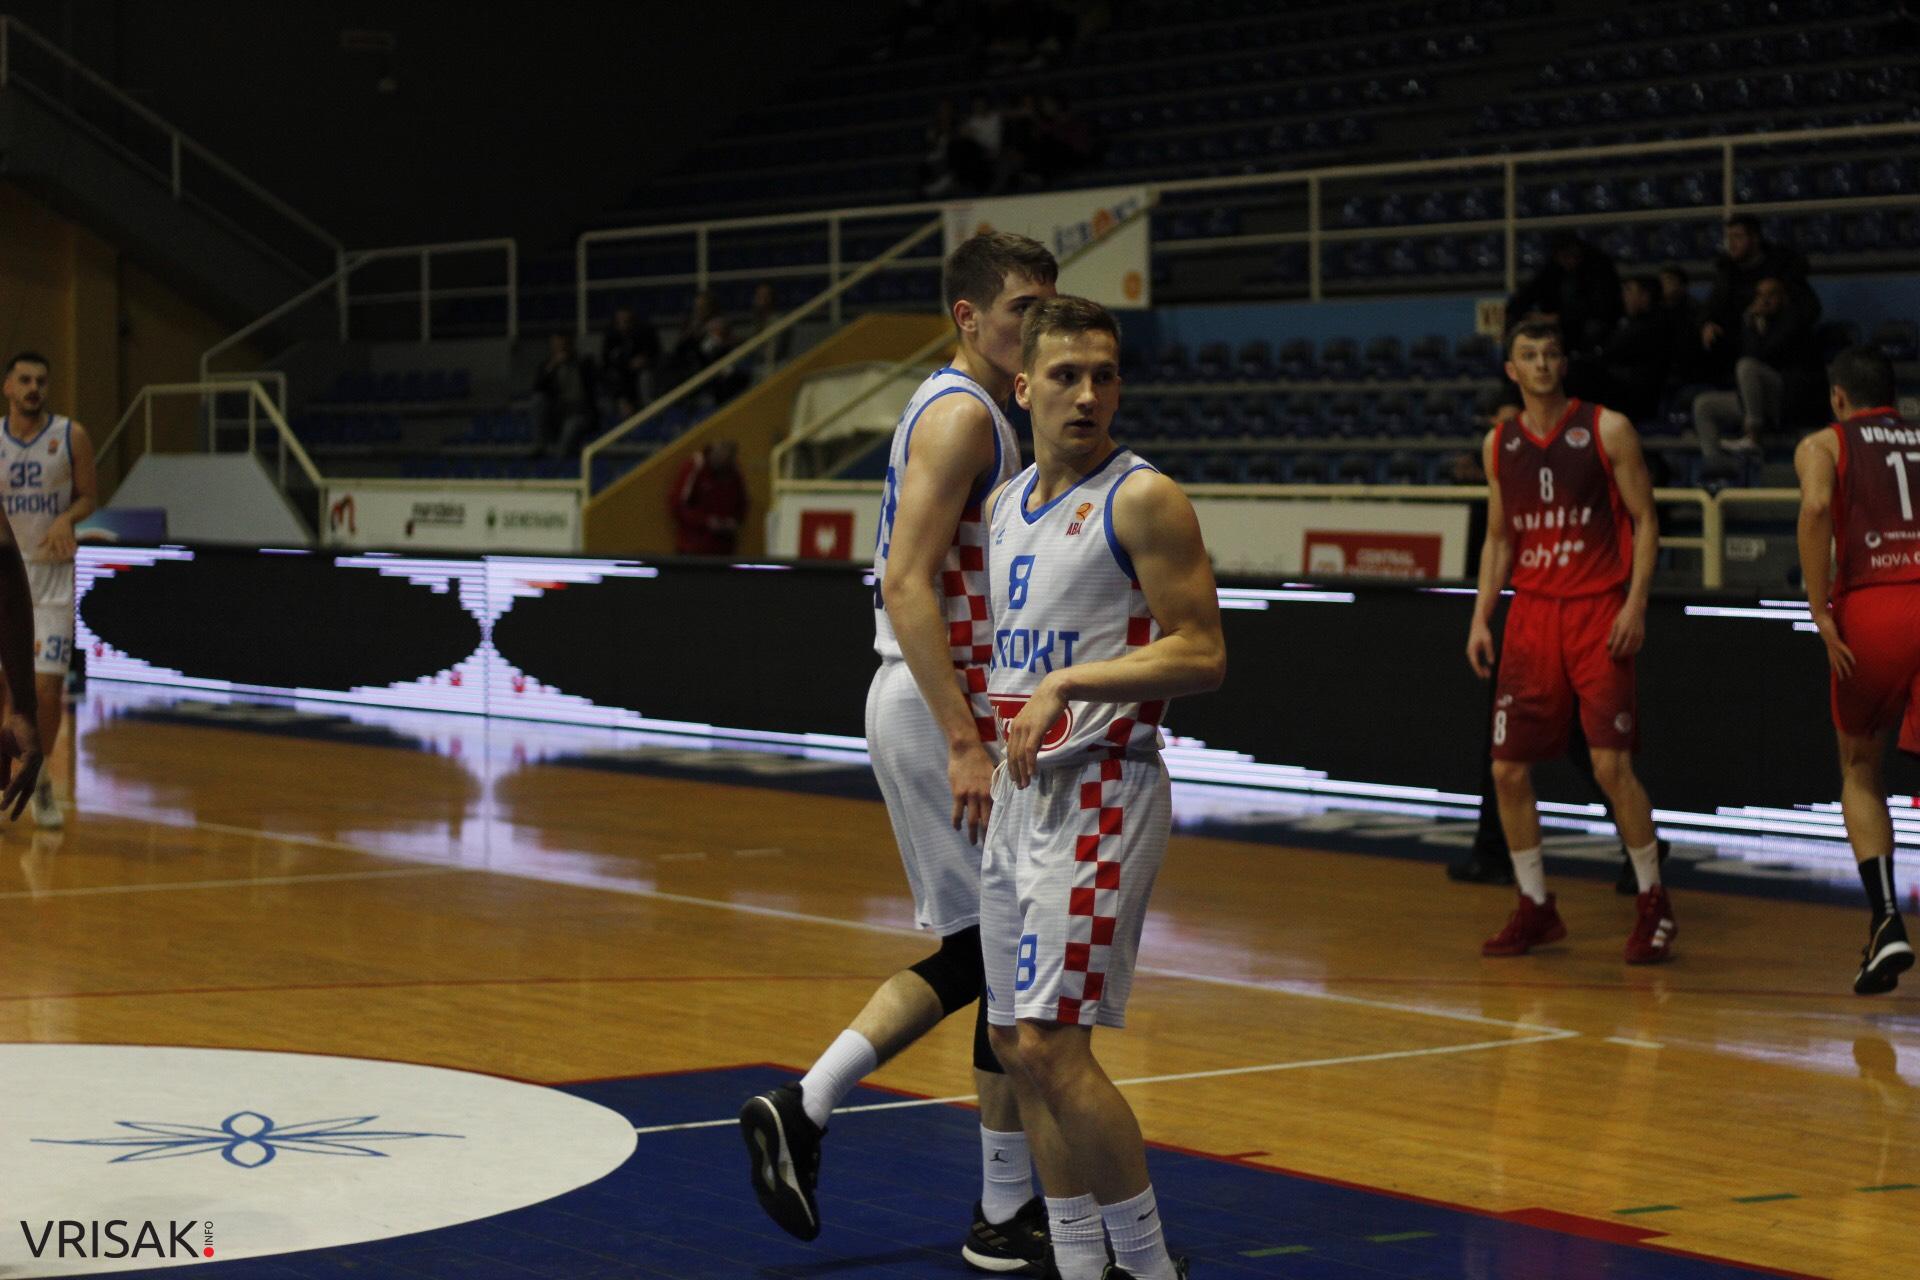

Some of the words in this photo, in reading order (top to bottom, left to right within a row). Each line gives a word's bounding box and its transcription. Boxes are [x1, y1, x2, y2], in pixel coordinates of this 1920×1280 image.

[10, 462, 41, 489] 32
[1539, 466, 1555, 503] 8
[1065, 522, 1083, 536] ABA
[1871, 552, 1911, 569] NOVA
[1009, 555, 1036, 610] 8
[1493, 709, 1508, 746] 8
[1016, 934, 1038, 991] 8
